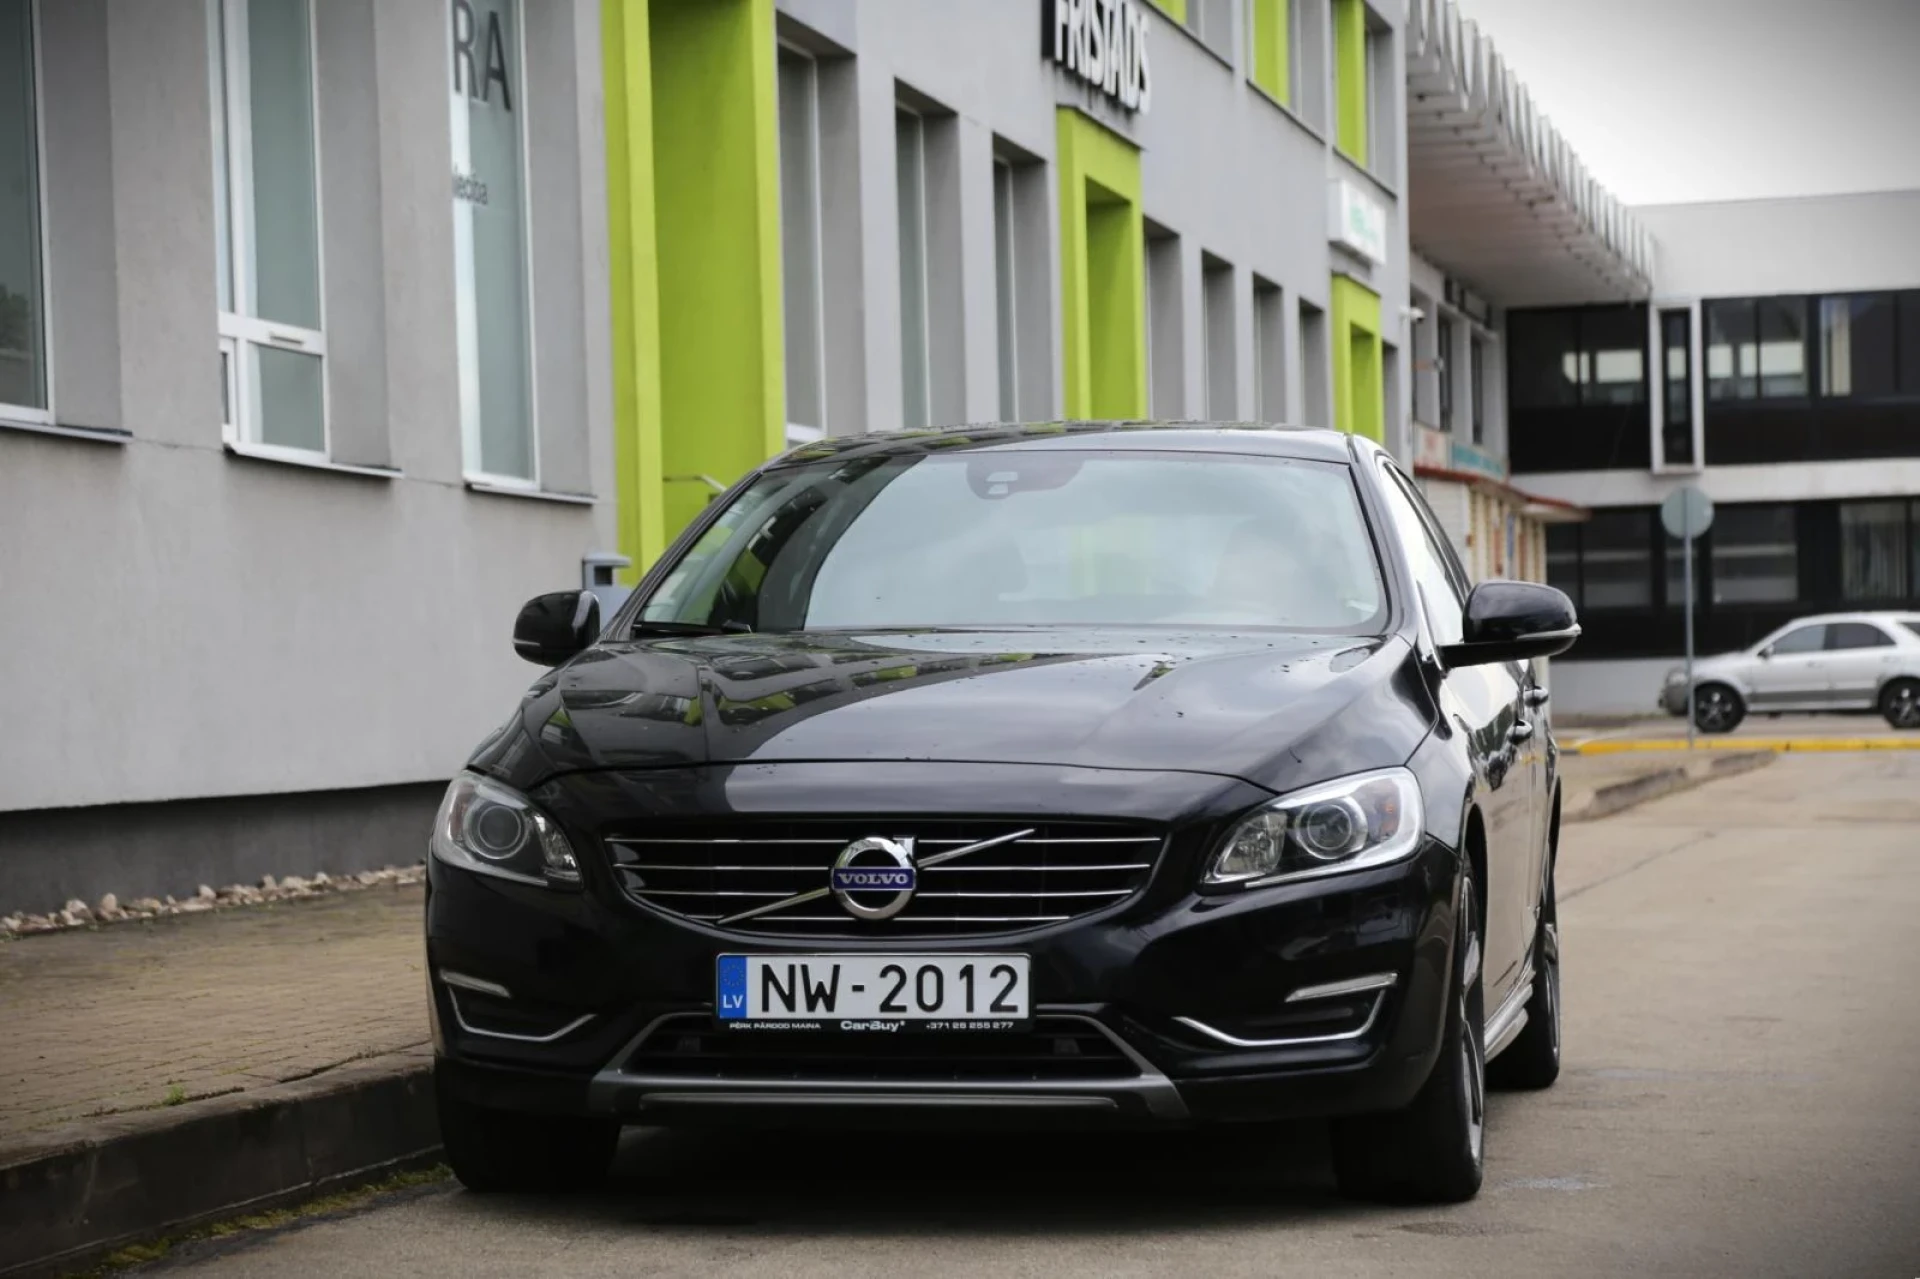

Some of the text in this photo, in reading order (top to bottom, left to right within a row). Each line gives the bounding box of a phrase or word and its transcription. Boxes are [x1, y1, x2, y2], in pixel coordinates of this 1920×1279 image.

[1055, 0, 1151, 114] FRISTADS
[838, 873, 909, 885] VOLVO
[722, 994, 744, 1009] LV
[761, 963, 1019, 1013] NW-2012
